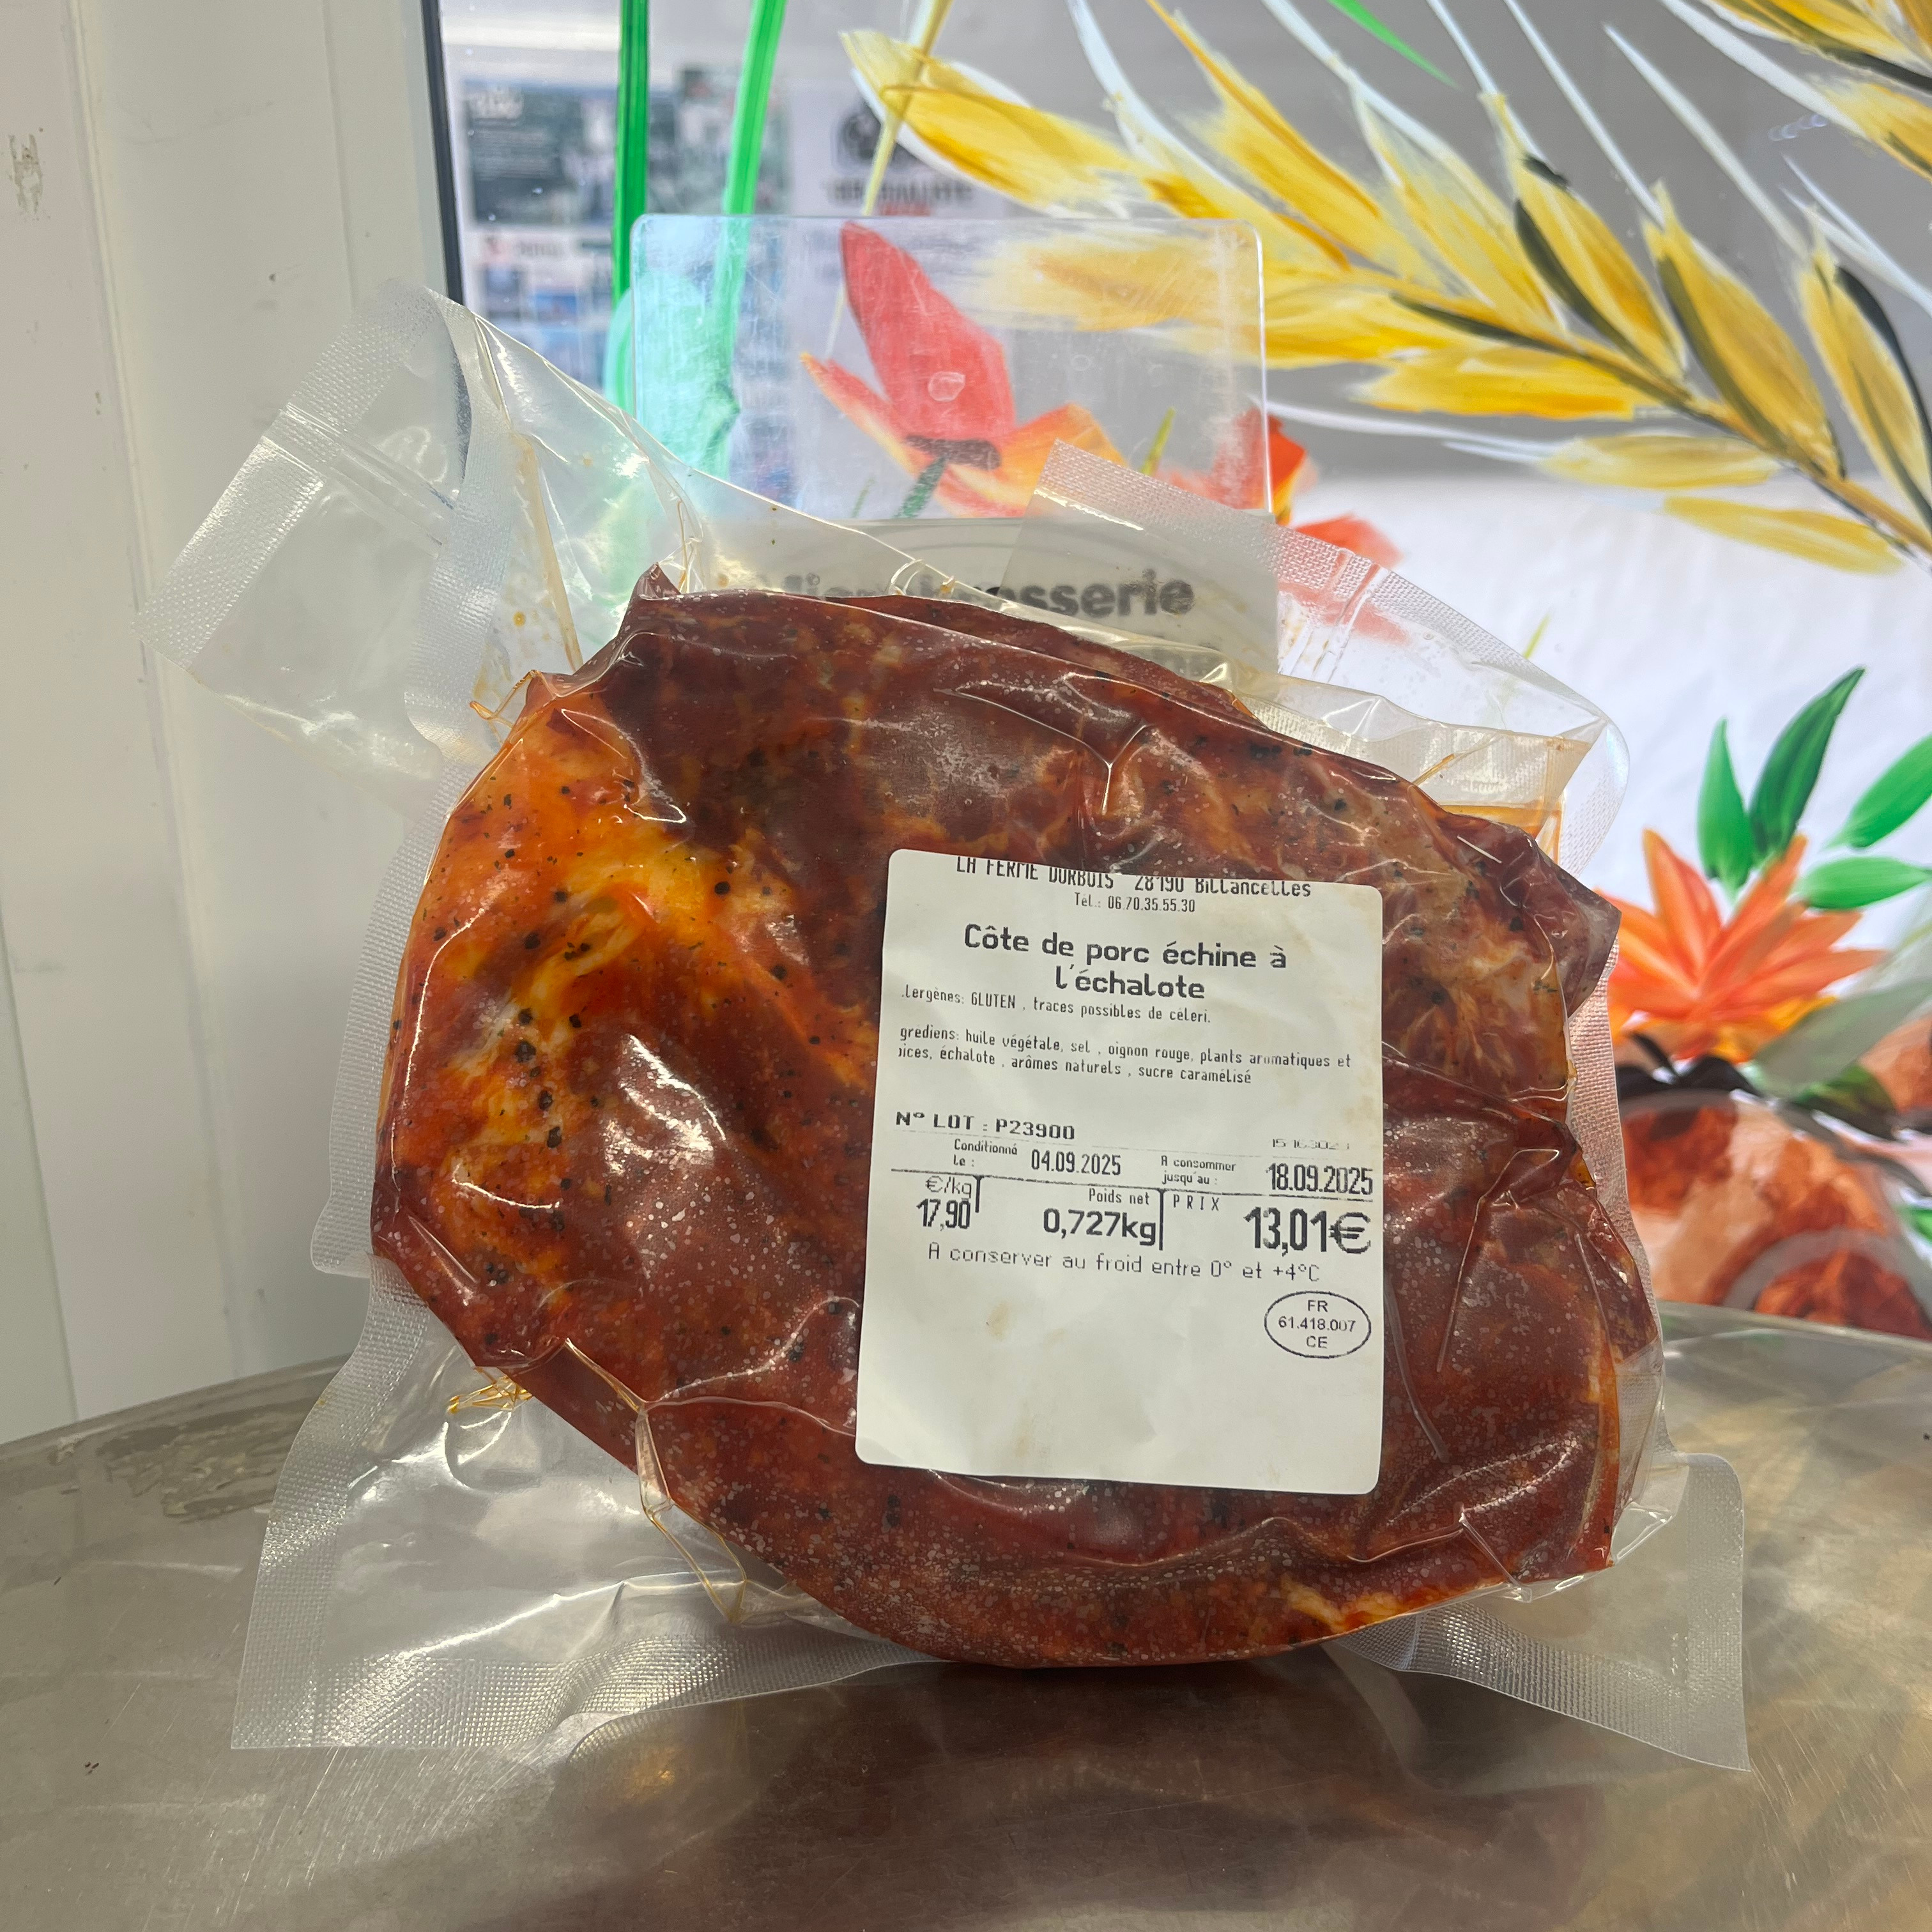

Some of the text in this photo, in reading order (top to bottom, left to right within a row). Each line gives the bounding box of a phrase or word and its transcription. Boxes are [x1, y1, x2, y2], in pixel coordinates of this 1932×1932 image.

[956, 856, 976, 874] LA
[986, 859, 1038, 880] FERME
[1107, 895, 1195, 912] 06.70.35.55.30
[964, 923, 1287, 969] Côte de porc échine à
[900, 983, 966, 1005] lergènes:
[971, 992, 1016, 1009] GLUTEN
[1033, 996, 1074, 1014] traces
[1080, 1002, 1141, 1019] possibles
[1148, 1006, 1162, 1020] de
[965, 1028, 995, 1046] huile
[1002, 1033, 1064, 1053] végétale,
[1070, 1039, 1091, 1054] sel
[1108, 1041, 1148, 1059] oignon
[1154, 1048, 1193, 1063] rouge,
[1200, 1048, 1242, 1065] plants
[1337, 1054, 1351, 1068] et
[940, 1041, 995, 1065] échalote
[1011, 1054, 1059, 1071] arômes
[1065, 1059, 1121, 1075] naturels
[1138, 1066, 1174, 1078] sucre
[1180, 1068, 1252, 1084] caramélisé
[933, 1113, 975, 1130] LOT
[994, 1117, 1076, 1140] P23900
[1031, 1148, 1121, 1176] 04.09.2025
[1161, 1154, 1237, 1175] A consommer
[925, 1174, 972, 1199] €/kg
[1266, 1162, 1374, 1195] 18.09.2025
[1089, 1187, 1150, 1206] Poids net
[916, 1199, 971, 1232] 17,90
[1043, 1207, 1157, 1247] 0,727kg
[1243, 1206, 1372, 1257] 13,01€
[928, 1241, 940, 1260] A
[949, 1248, 1052, 1268] conserver
[1062, 1255, 1085, 1270] au
[1096, 1252, 1142, 1273] froid
[1151, 1257, 1201, 1277] entre
[1242, 1261, 1262, 1279] et
[1273, 1262, 1320, 1282] +4°C
[1307, 1299, 1329, 1313] FR
[1278, 1315, 1356, 1333] 61.418.007
[1306, 1335, 1328, 1349] CE
